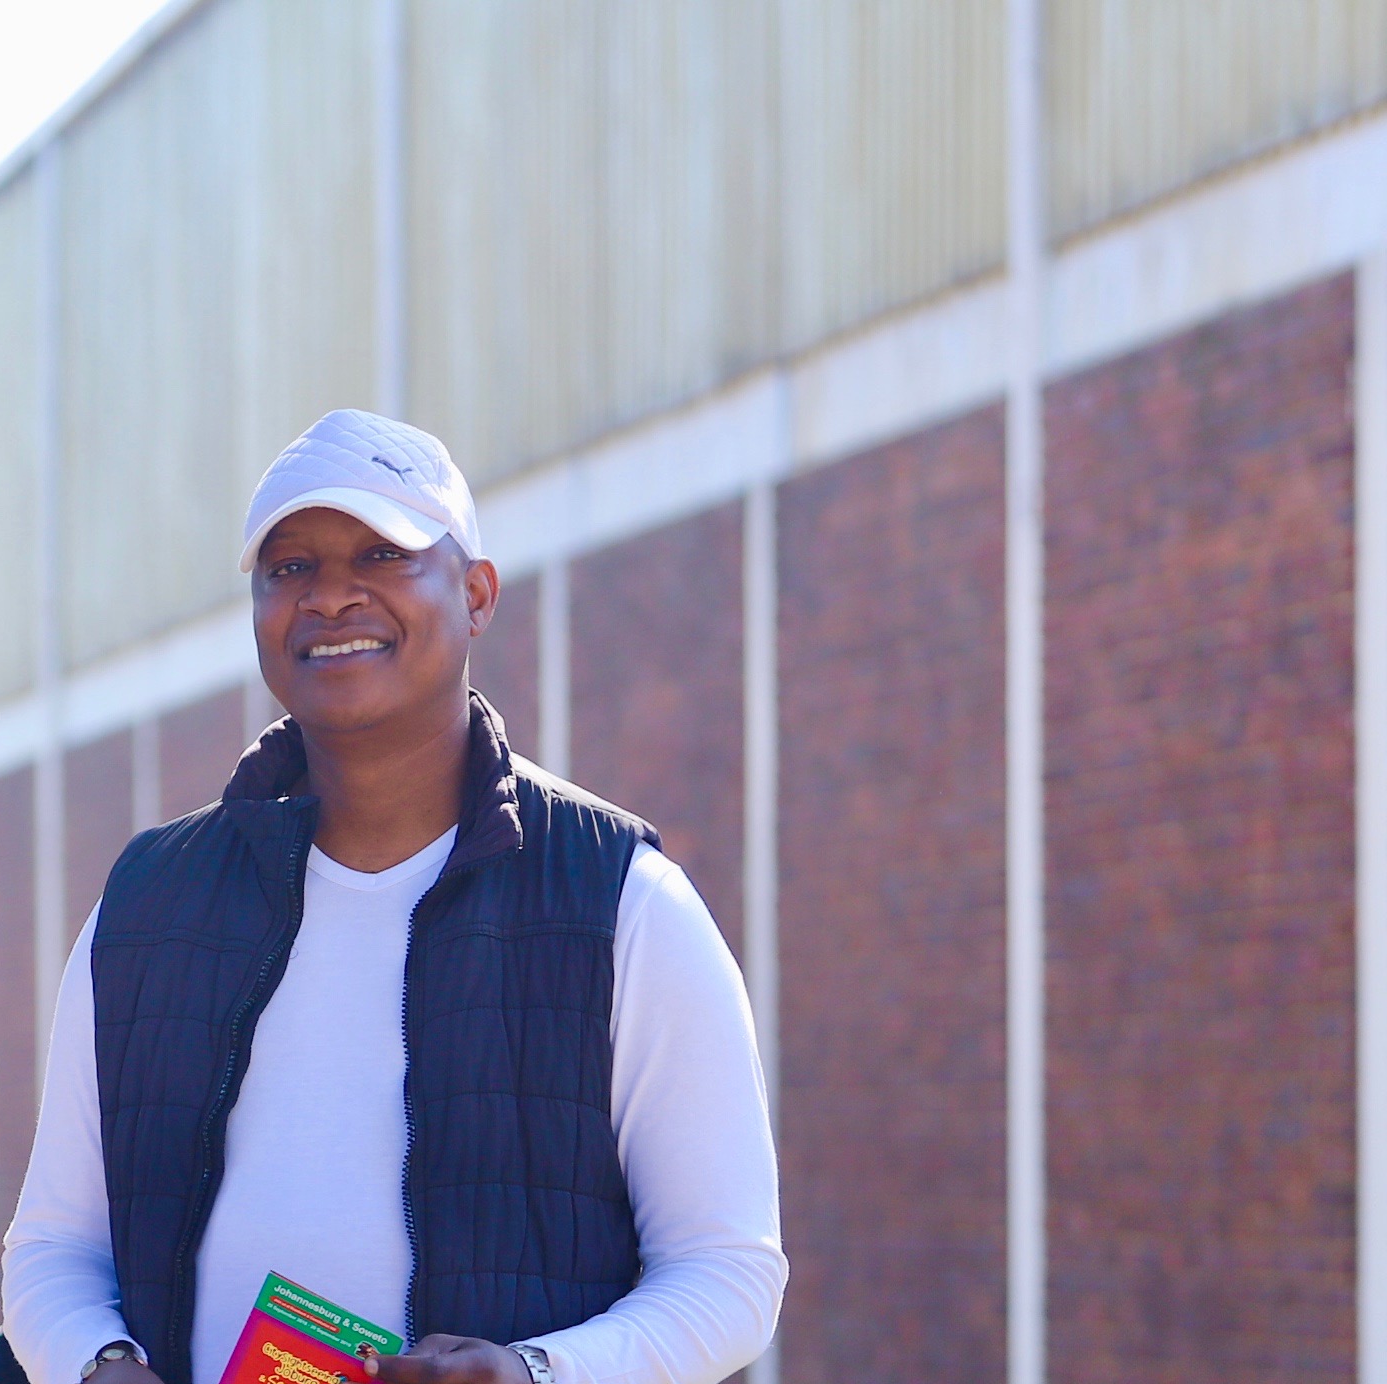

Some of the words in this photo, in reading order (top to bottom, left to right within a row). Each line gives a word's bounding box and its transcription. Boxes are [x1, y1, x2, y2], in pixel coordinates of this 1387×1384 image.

[273, 1284, 342, 1324] Johannesburg
[342, 1317, 351, 1328] &
[352, 1322, 388, 1345] Soweto
[258, 1374, 267, 1383] &
